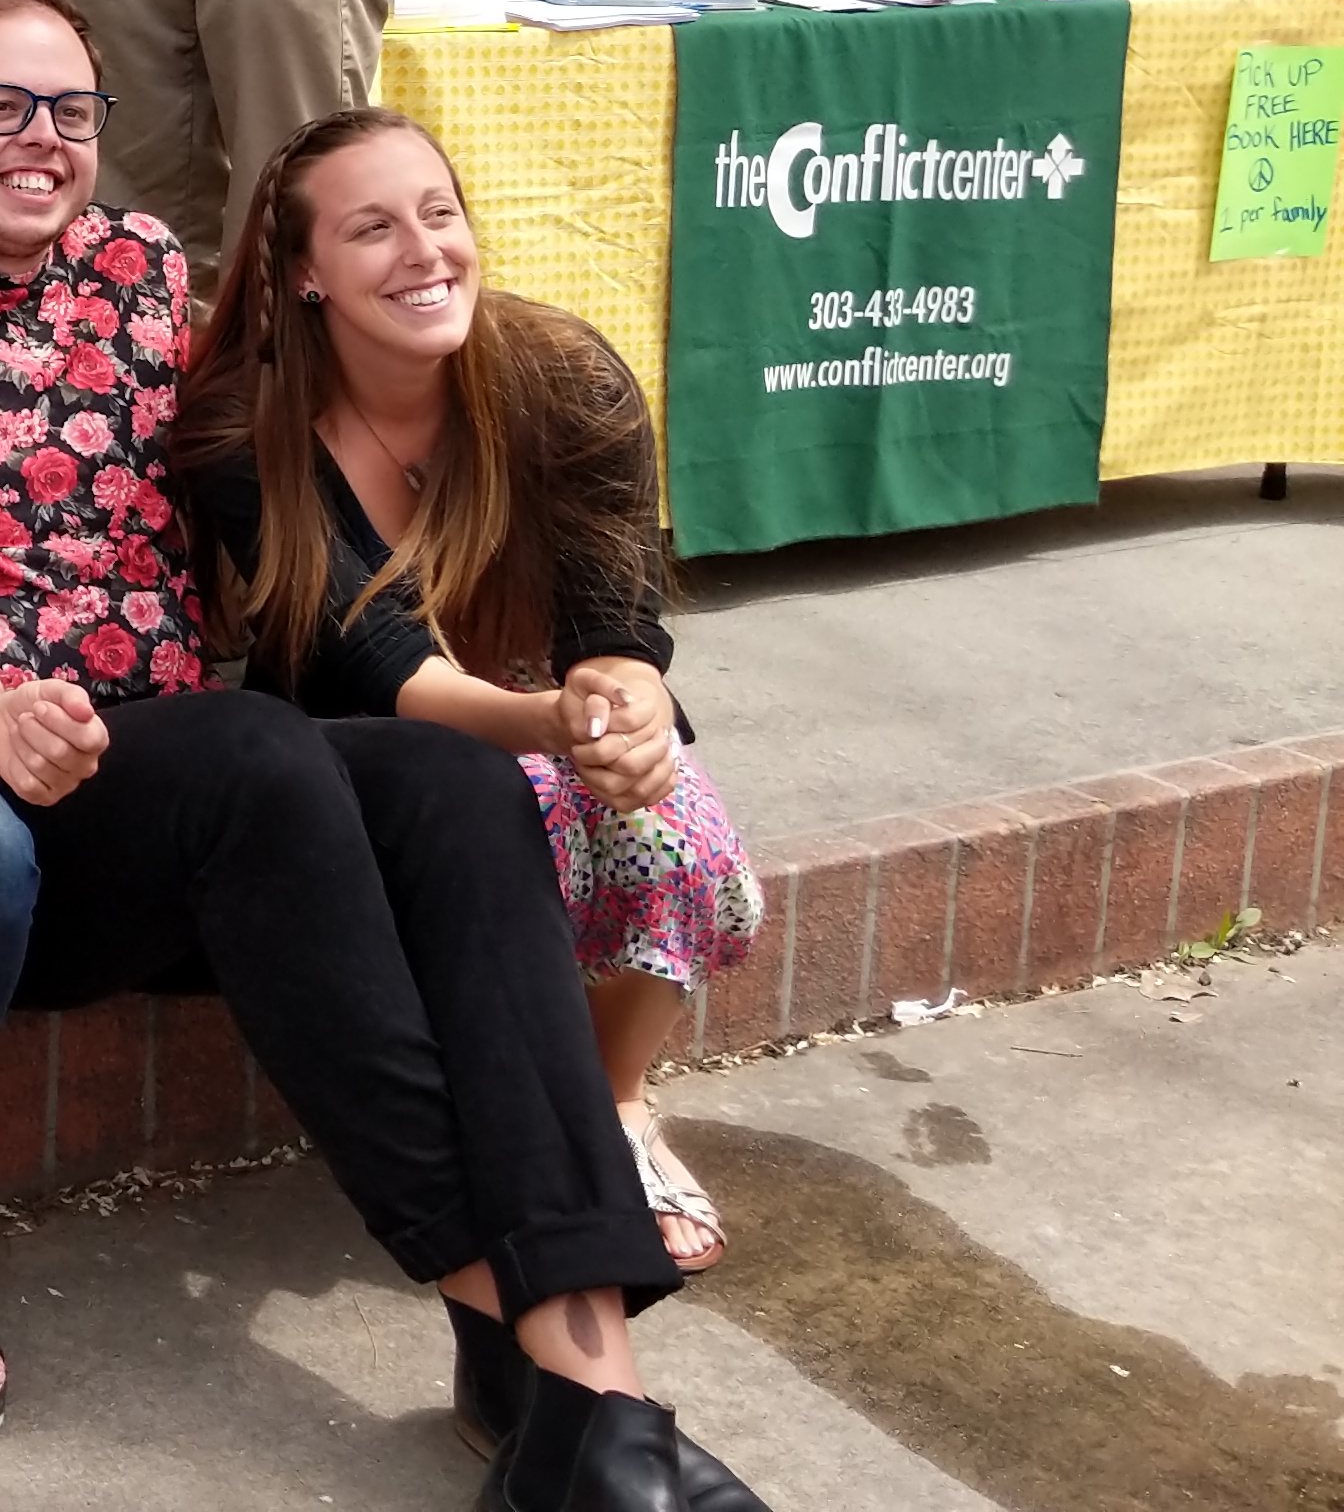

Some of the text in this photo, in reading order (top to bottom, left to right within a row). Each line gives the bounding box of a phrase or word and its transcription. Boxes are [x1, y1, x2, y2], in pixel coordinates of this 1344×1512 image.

[1245, 93, 1300, 120] FREE
[1227, 118, 1340, 152] BOOK HERE
[1240, 205, 1265, 233] per
[1271, 194, 1328, 233] family
[808, 285, 975, 330] 303-433-4983
[763, 346, 1012, 393] www.conflictcenter.org
